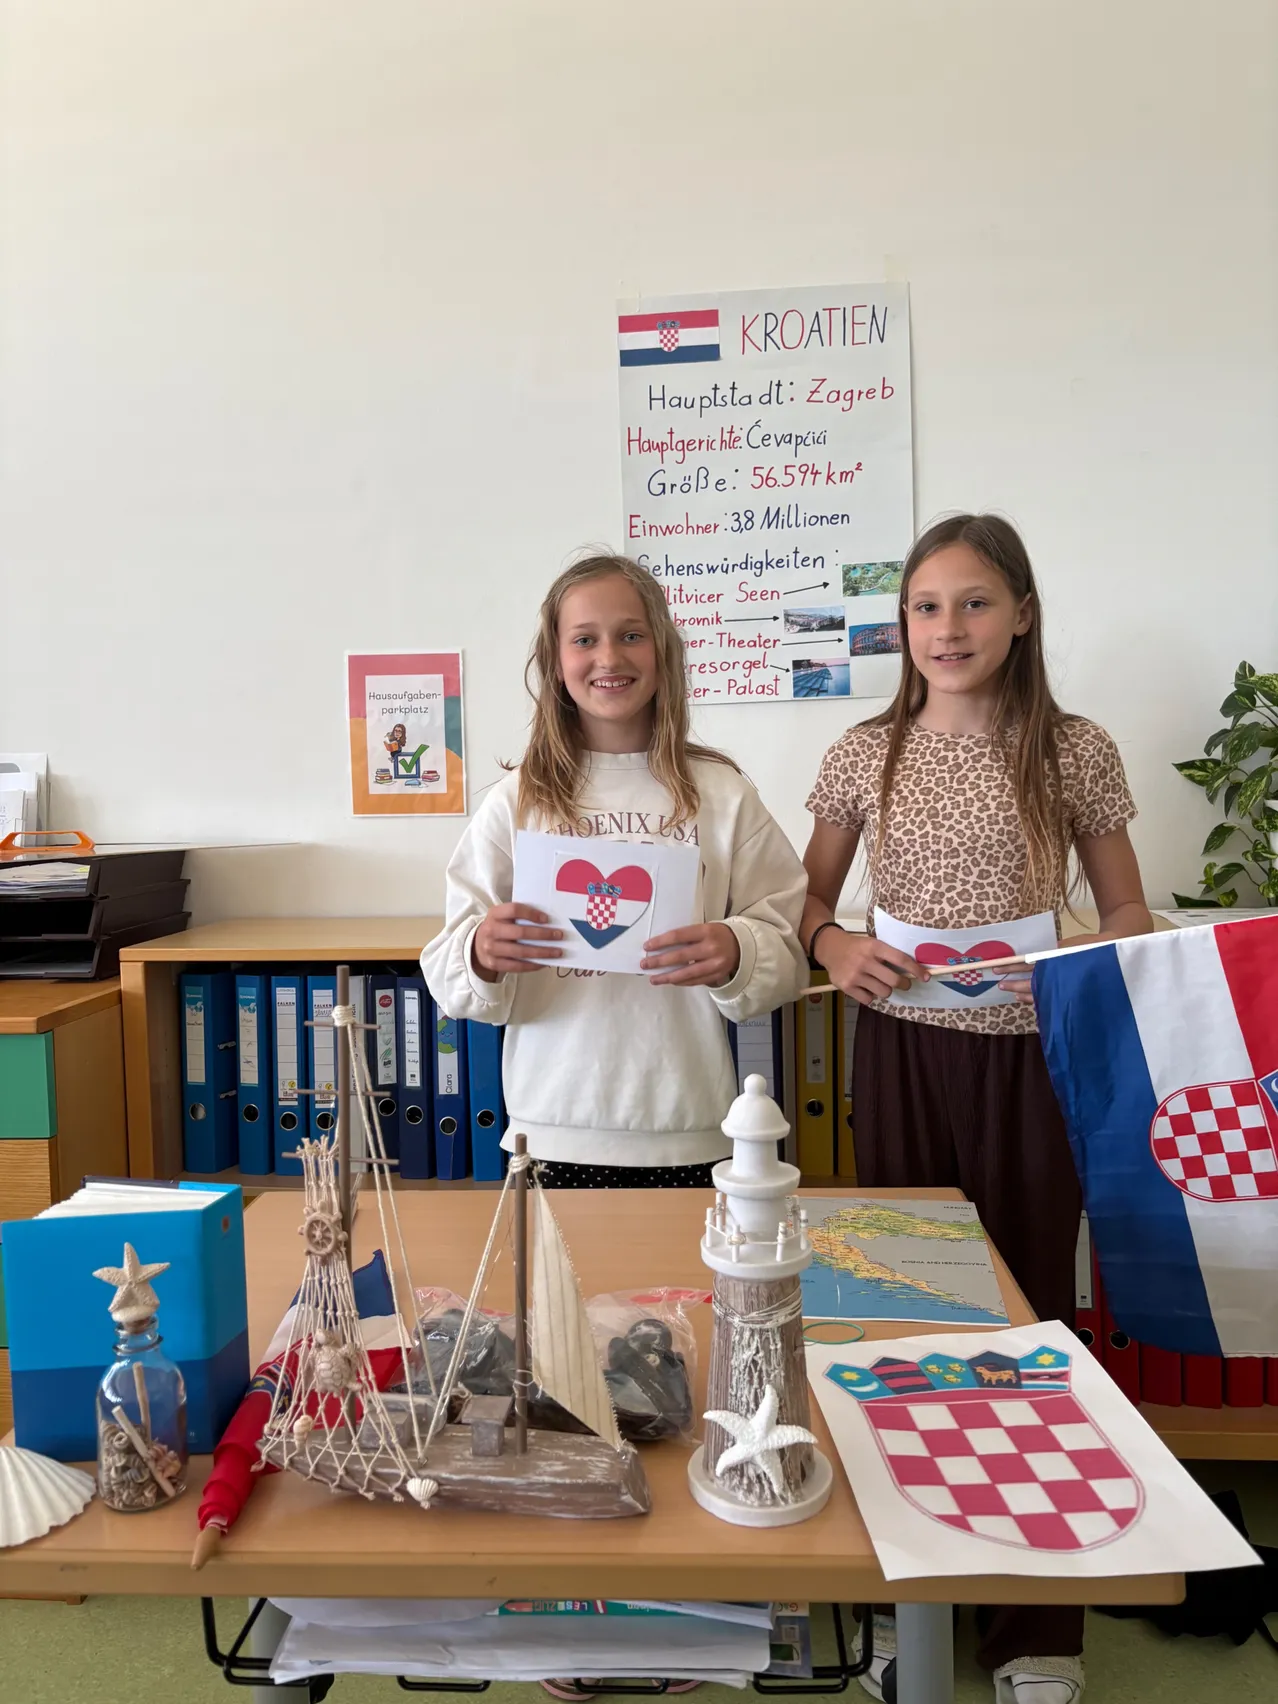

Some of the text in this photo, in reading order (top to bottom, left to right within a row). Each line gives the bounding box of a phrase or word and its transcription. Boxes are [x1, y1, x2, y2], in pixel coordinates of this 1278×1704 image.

[741, 304, 888, 355] KROATIEN
[648, 377, 895, 418] Hauptstadt: Zagreb
[627, 424, 744, 464] Hauptgerichte:
[647, 466, 740, 496] Größe:
[750, 463, 822, 489] 56.594
[759, 503, 851, 531] Millionen
[735, 581, 781, 603] Seen
[673, 611, 723, 627] brovnik
[684, 632, 781, 649] er-Theater
[687, 651, 769, 678] resorgel
[368, 689, 442, 702] Hausaufgaben-
[381, 705, 430, 716] parkplatz
[545, 811, 700, 847] HOENIX USA
[445, 1073, 453, 1094] Clara
